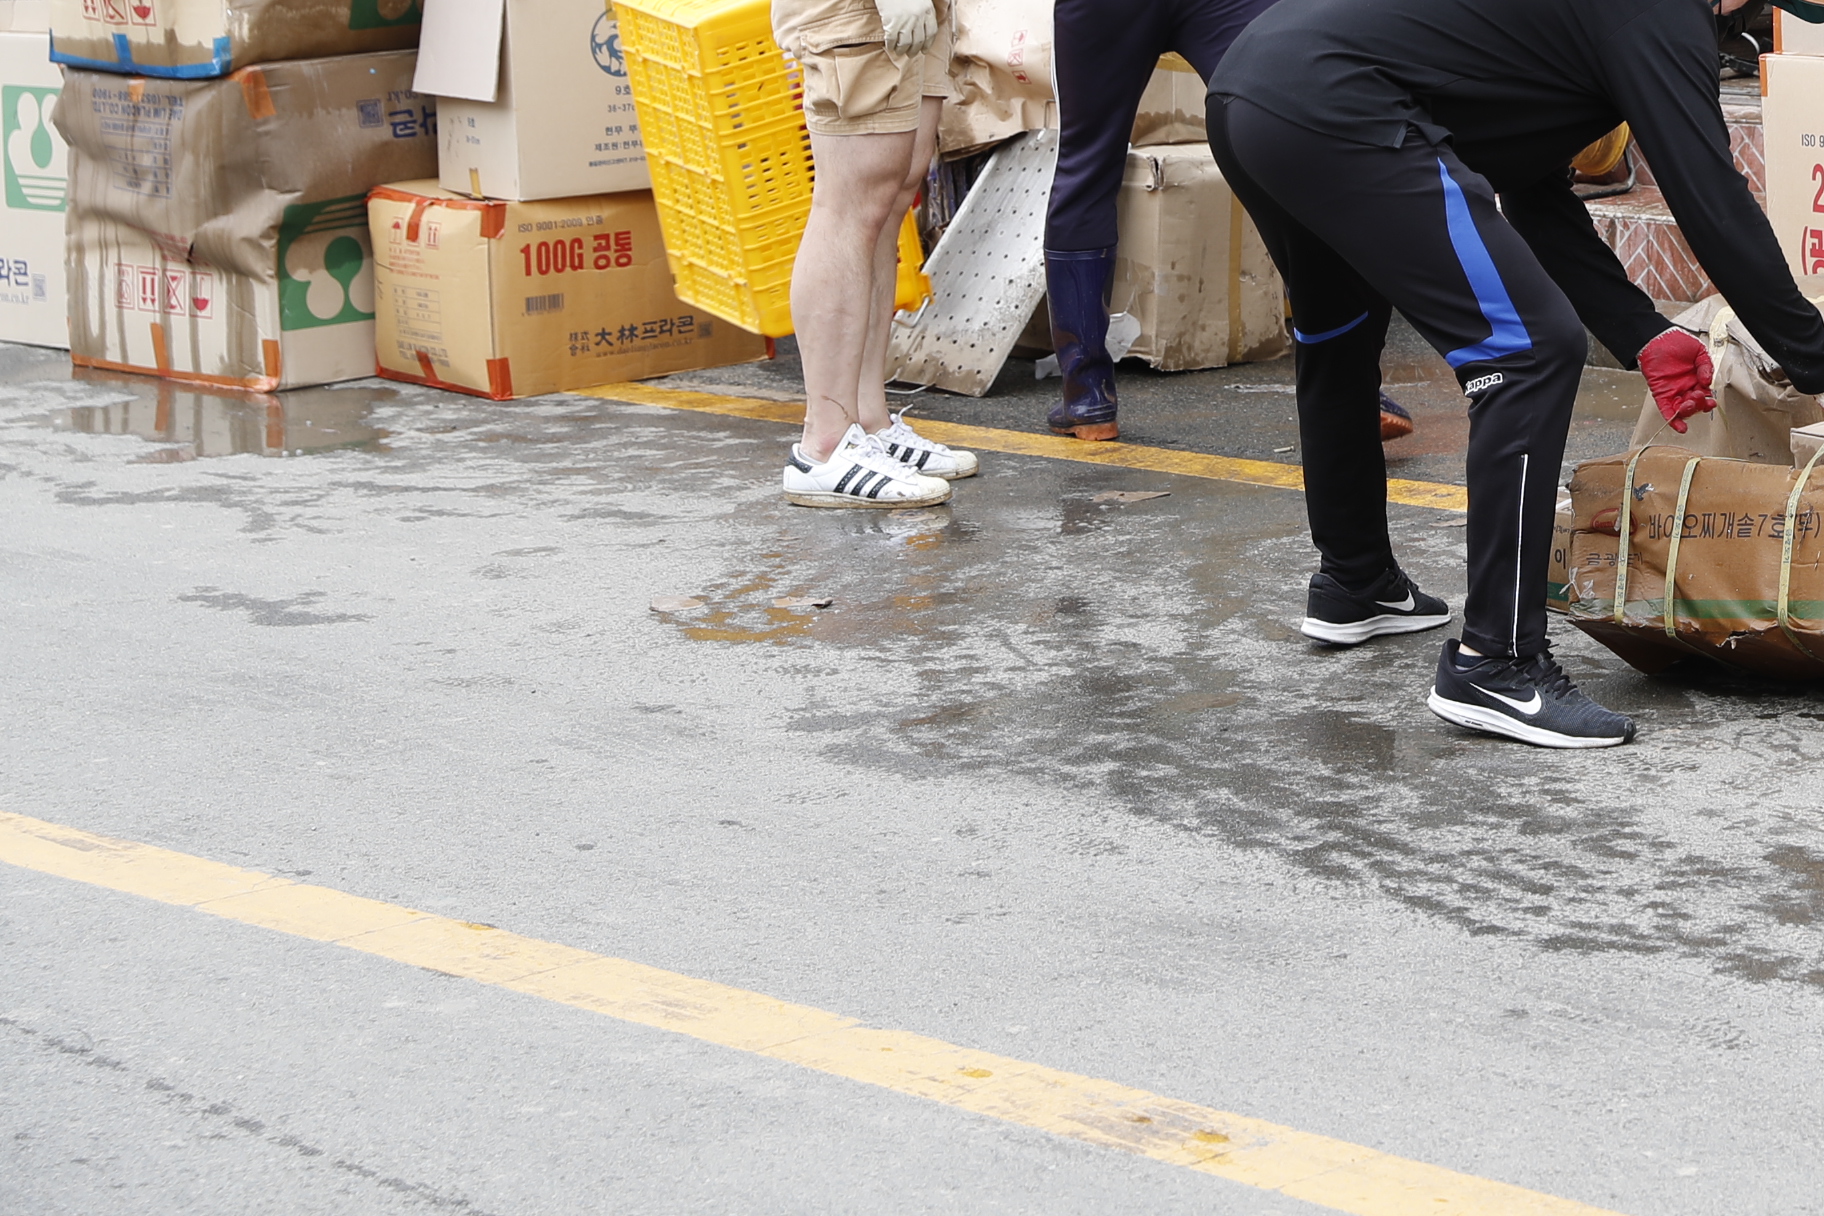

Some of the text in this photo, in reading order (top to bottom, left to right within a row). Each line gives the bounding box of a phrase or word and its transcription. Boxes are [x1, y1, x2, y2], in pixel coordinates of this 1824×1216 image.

[1801, 134, 1815, 147] ISO
[518, 222, 533, 234] ISO
[520, 231, 633, 276] 100G 공통
[594, 315, 695, 348] 大林프라콘
